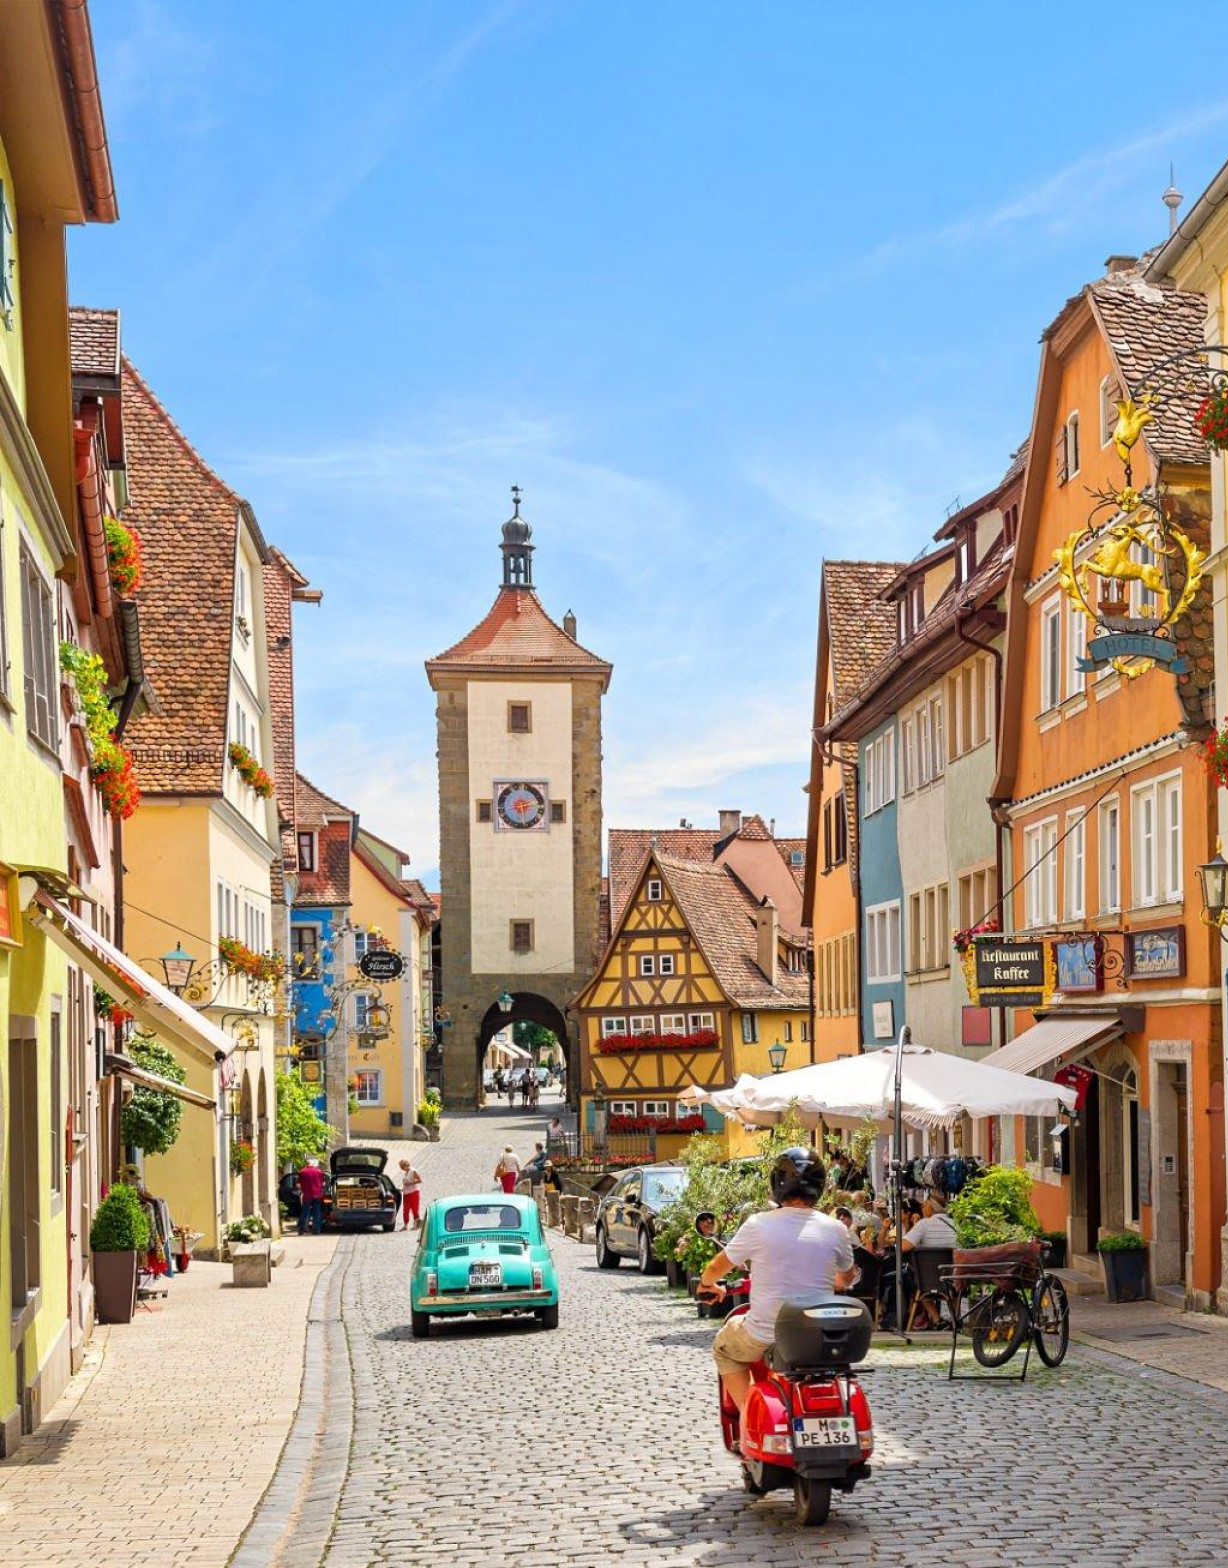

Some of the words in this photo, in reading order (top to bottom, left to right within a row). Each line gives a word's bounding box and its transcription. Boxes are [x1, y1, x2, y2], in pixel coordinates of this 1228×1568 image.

[1104, 637, 1160, 655] HOTEL
[993, 966, 1030, 980] Kaffee
[818, 1419, 829, 1431] M
[801, 1432, 820, 1445] PE
[823, 1431, 850, 1444] 136
